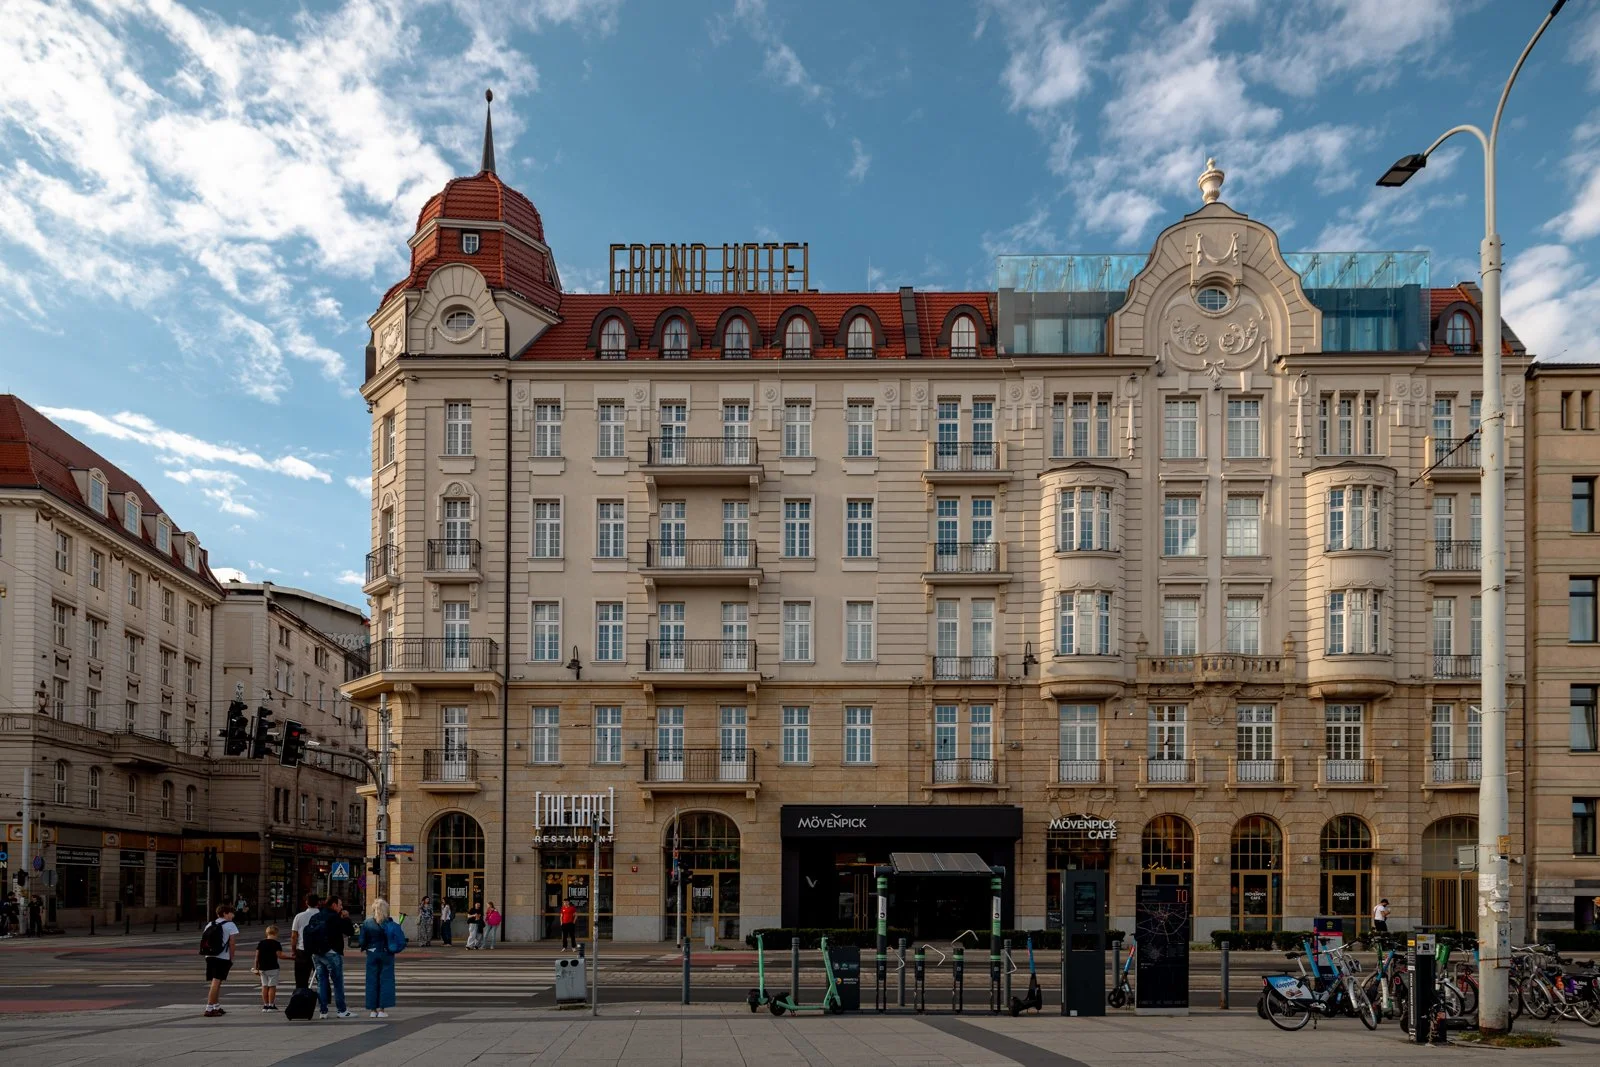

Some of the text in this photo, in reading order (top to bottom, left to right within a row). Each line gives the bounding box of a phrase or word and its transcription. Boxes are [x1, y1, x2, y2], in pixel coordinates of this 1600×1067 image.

[610, 242, 819, 294] GRAND HOTEL
[535, 835, 614, 843] RESTAURNT
[1088, 828, 1117, 839] CAFÉ
